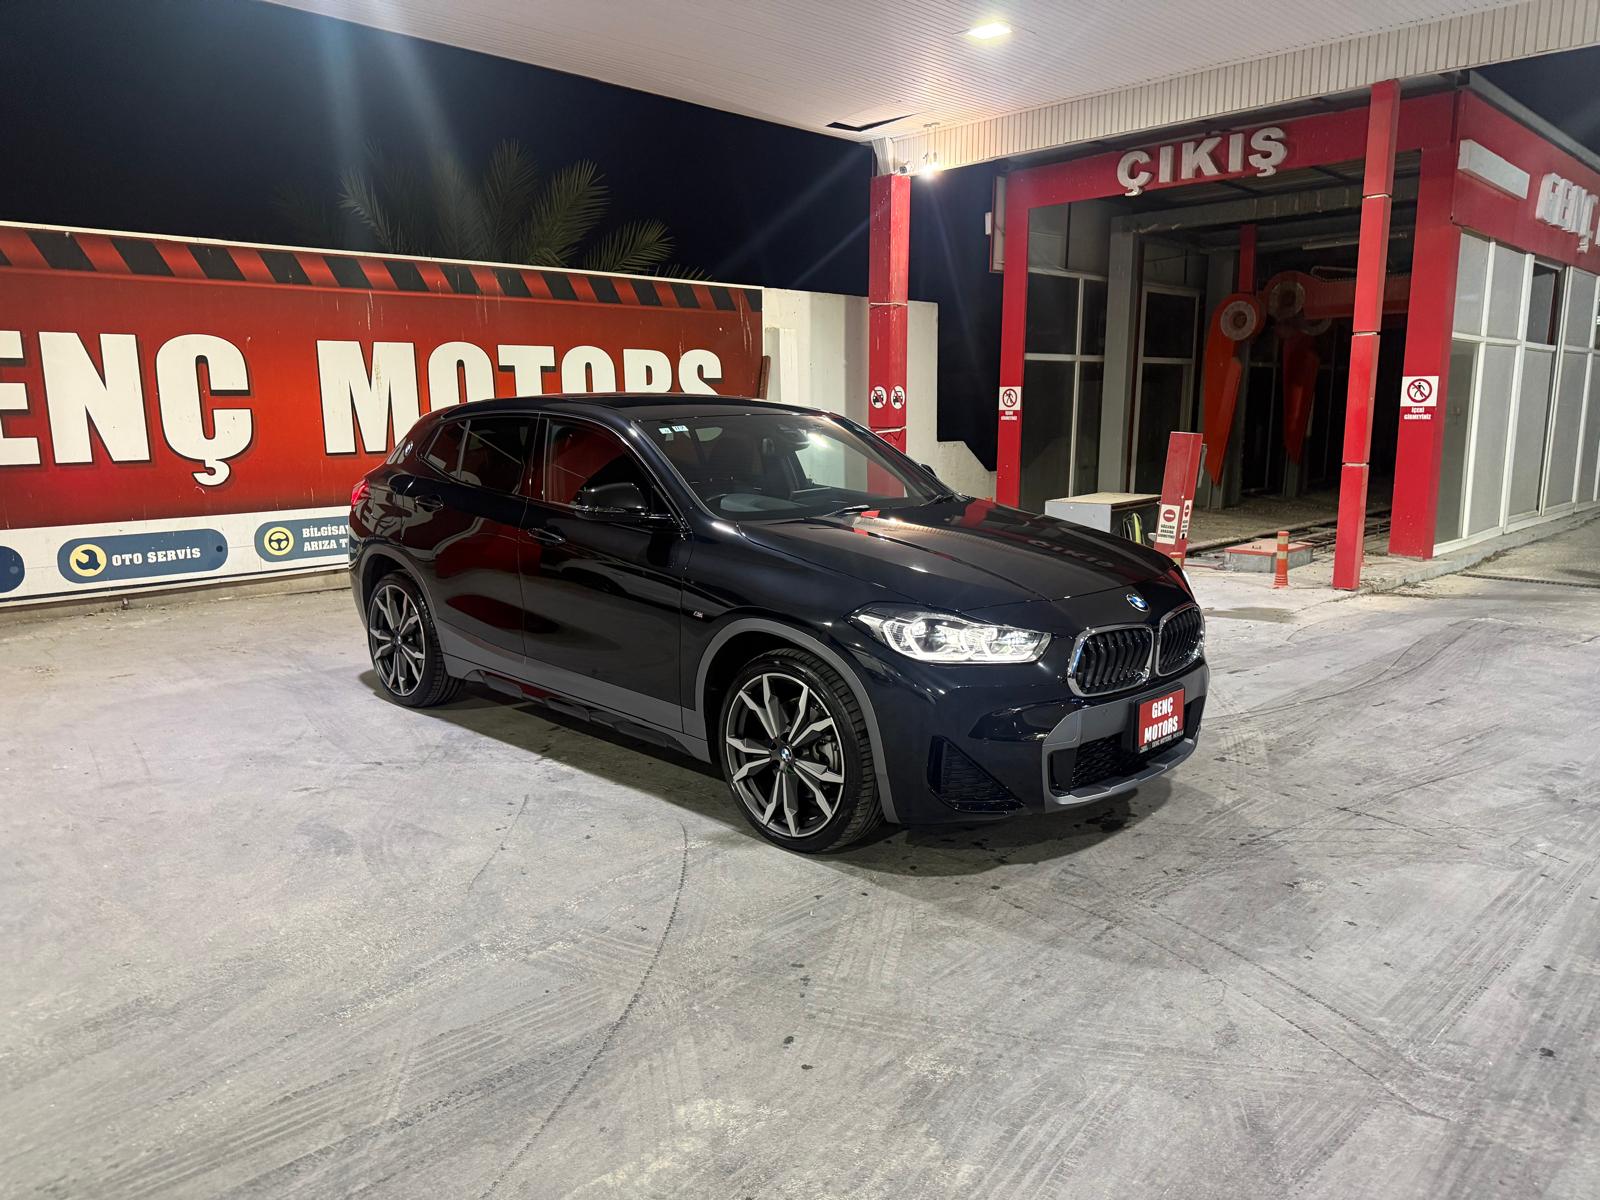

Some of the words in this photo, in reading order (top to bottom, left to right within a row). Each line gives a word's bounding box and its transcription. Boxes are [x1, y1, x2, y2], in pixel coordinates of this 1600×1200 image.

[1117, 127, 1287, 196] ÇIKIŞ
[304, 539, 337, 552] ARIZA
[112, 552, 143, 567] OTO
[147, 546, 201, 564] SERVİS
[1152, 697, 1173, 718] GENÇ
[1144, 716, 1178, 743] MOTORS
